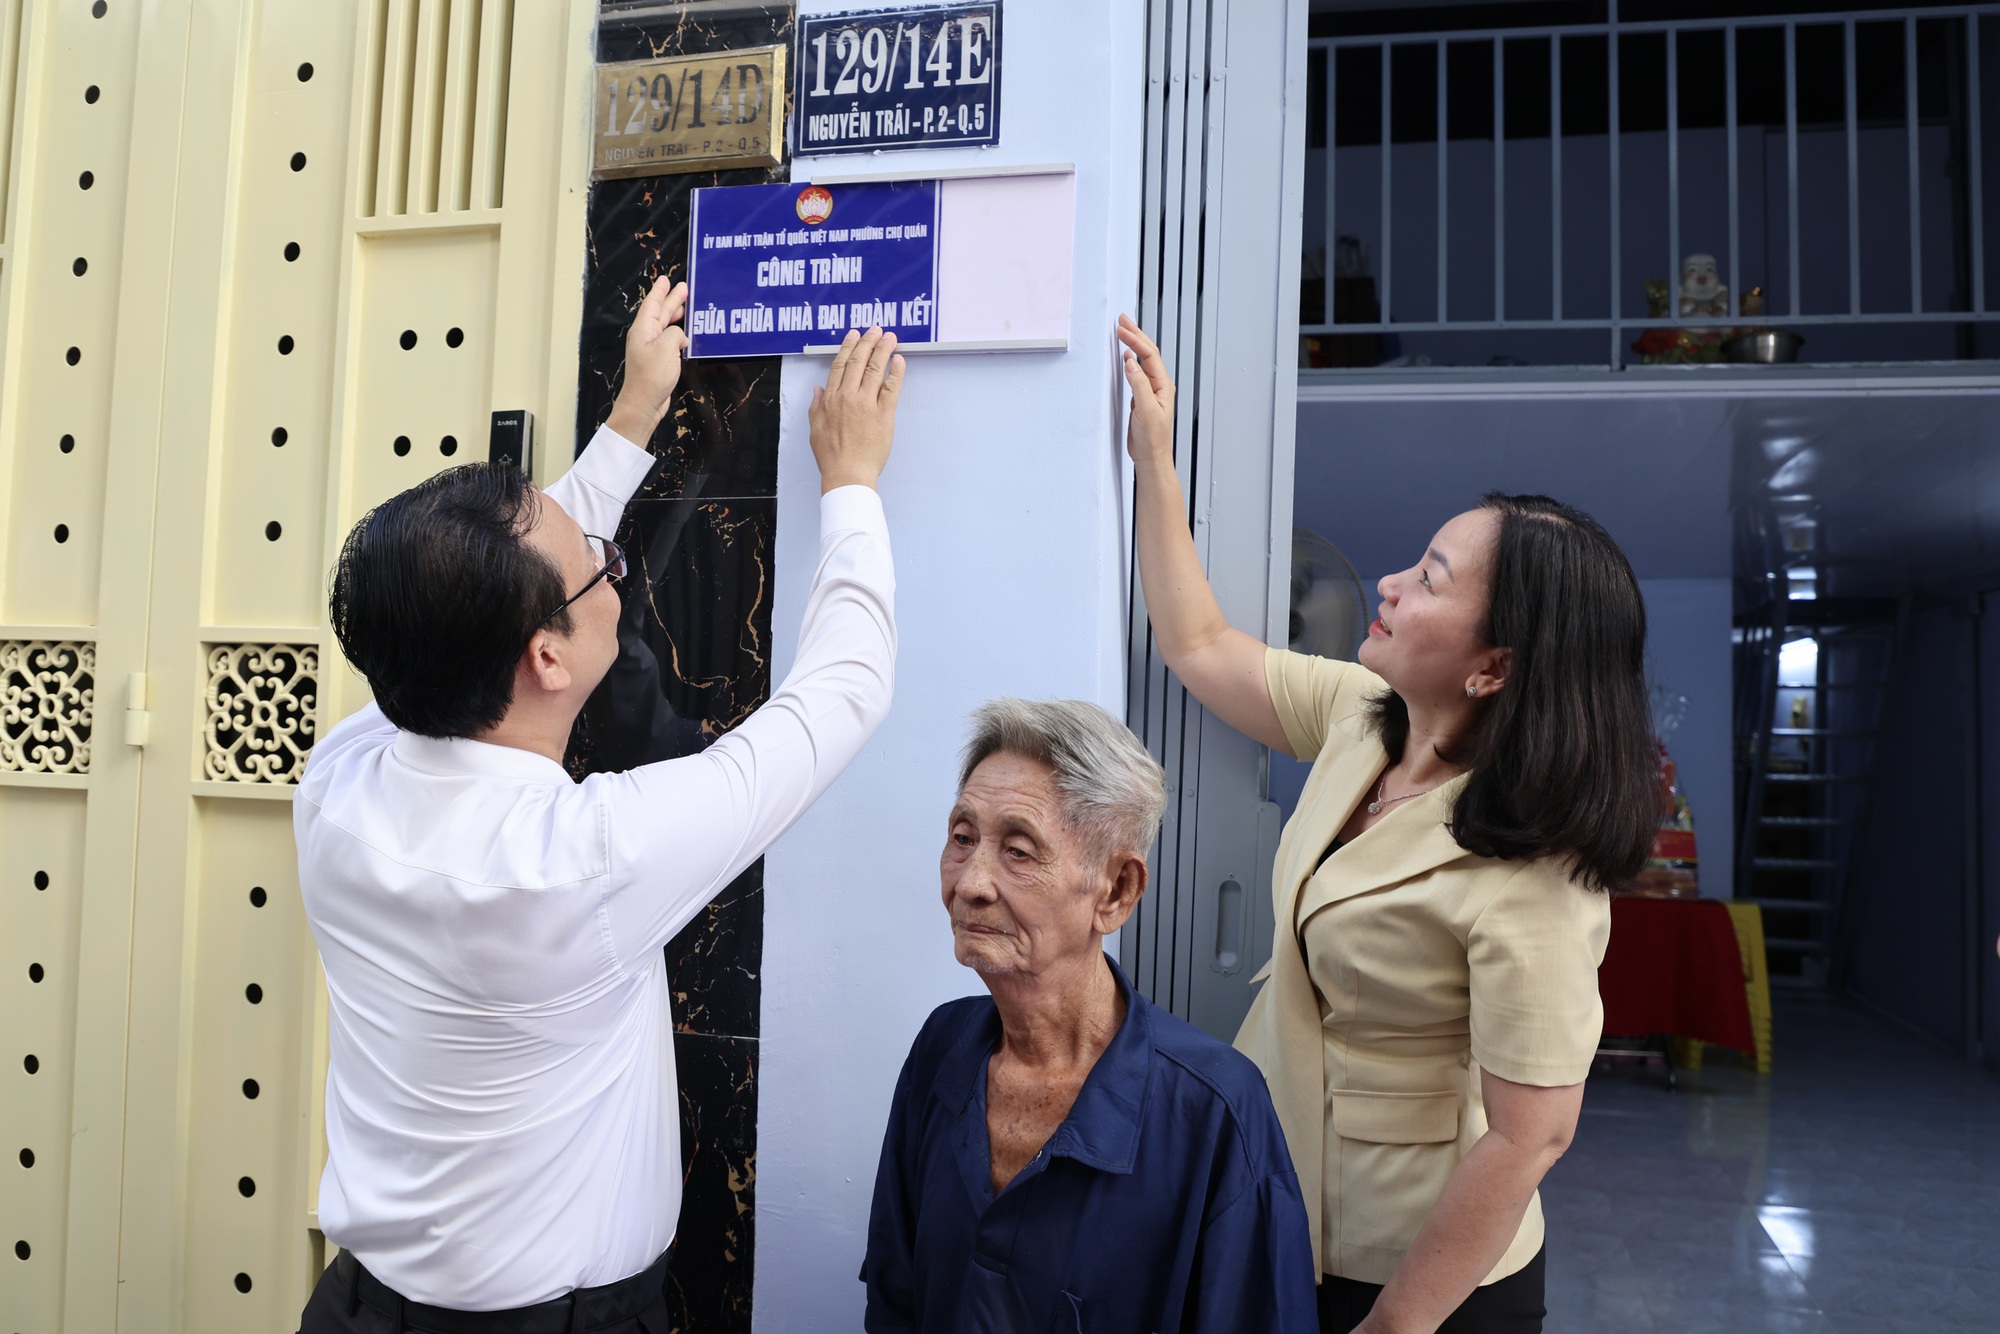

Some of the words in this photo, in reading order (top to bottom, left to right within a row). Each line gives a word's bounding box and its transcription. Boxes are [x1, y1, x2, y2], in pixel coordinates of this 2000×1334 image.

[810, 16, 991, 97] 129/14E
[603, 64, 764, 137] 129/14D
[808, 101, 871, 141] NGUYỄN
[876, 103, 910, 136] TRÃI
[703, 233, 715, 249] ỦY
[715, 235, 733, 249] BAN
[734, 232, 753, 251] MẶT
[753, 231, 775, 250] TRẬN
[776, 228, 786, 246] TỔ
[787, 227, 810, 247] QUỐC
[810, 228, 828, 247] VIỆT
[828, 229, 850, 243] NAM
[850, 225, 885, 242] PHƯỜNG
[885, 224, 904, 242] CHỢ
[904, 222, 928, 240] QUÁN
[757, 255, 806, 288] CÔNG
[809, 252, 863, 285] TRÌNH
[693, 302, 727, 335] SỬA
[729, 302, 774, 334] CHỮA
[778, 301, 814, 332] NHÀ
[817, 303, 846, 336] ĐẠI
[850, 297, 898, 329] ĐOÀN
[901, 292, 932, 327] KẾT
